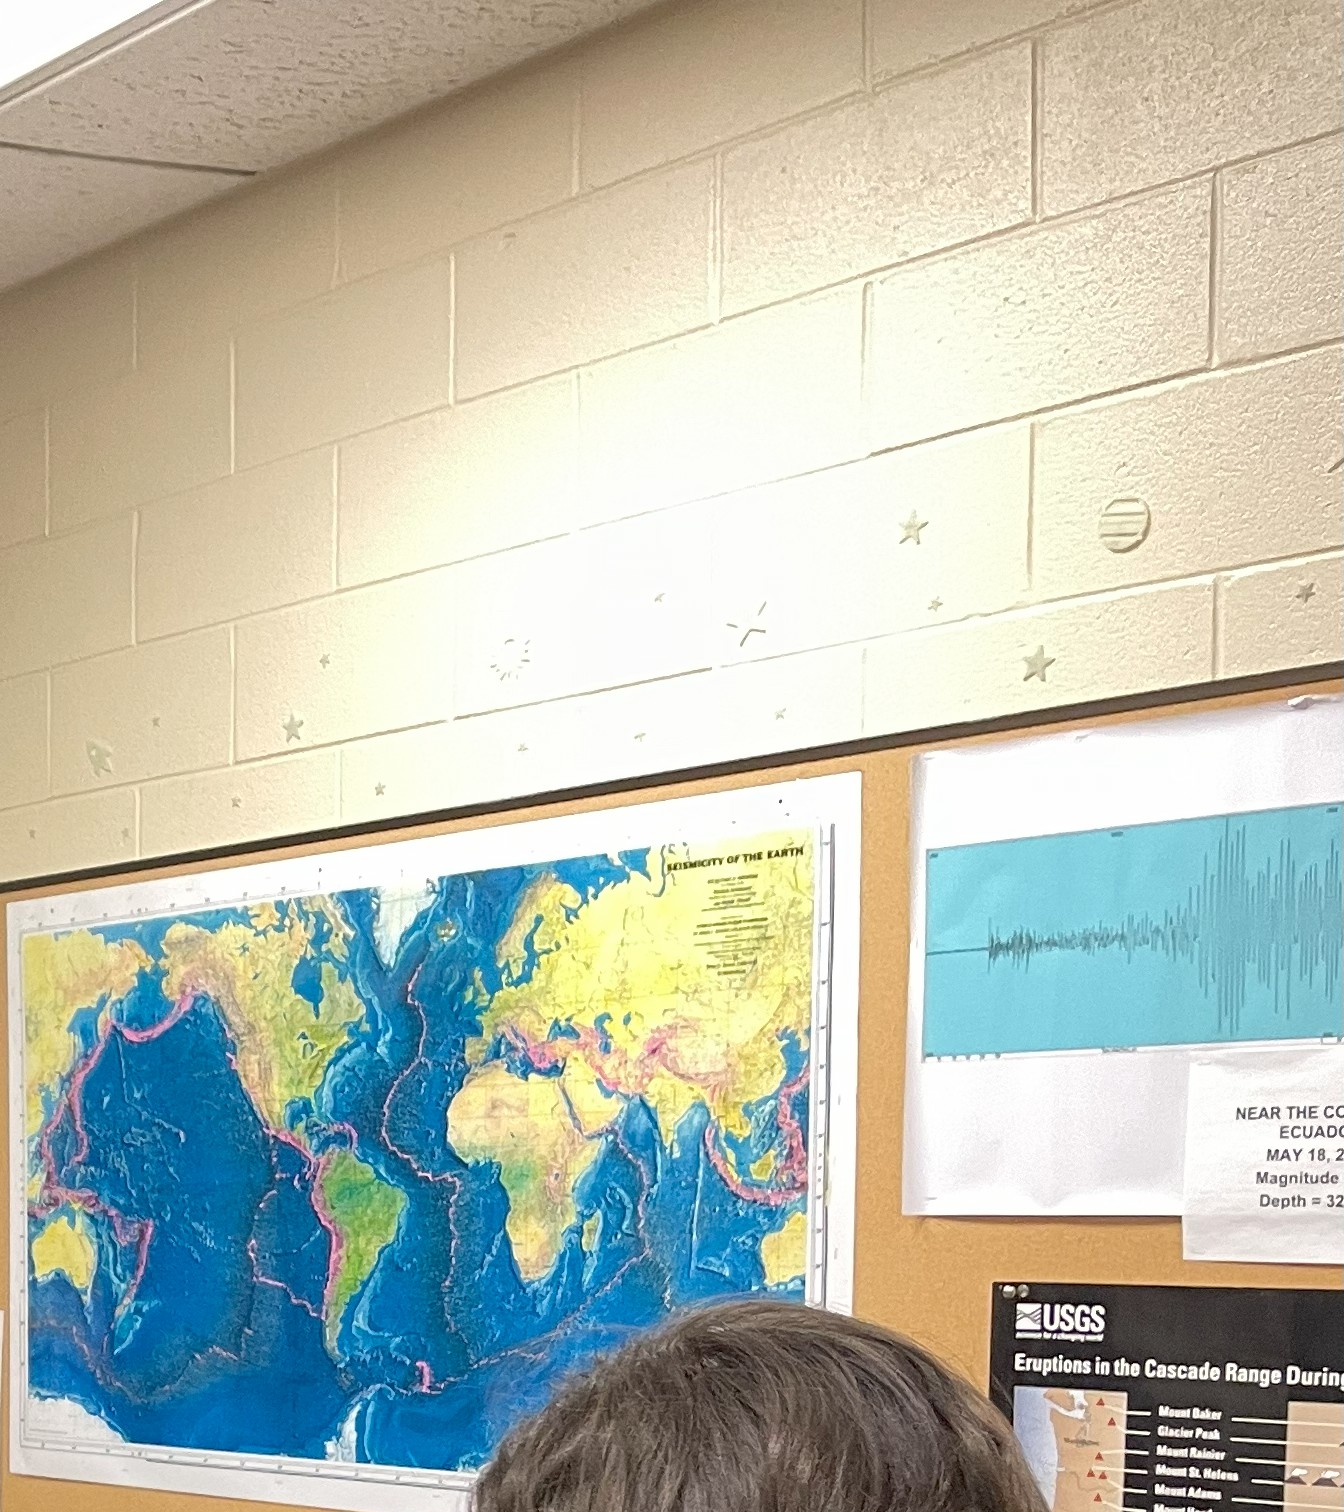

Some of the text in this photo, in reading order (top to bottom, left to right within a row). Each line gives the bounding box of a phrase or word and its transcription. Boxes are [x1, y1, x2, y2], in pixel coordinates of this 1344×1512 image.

[667, 847, 804, 872] SEISMICITY OF THE EARTH
[1236, 1106, 1281, 1120] NEAR
[1287, 1105, 1320, 1120] THE
[1266, 1148, 1303, 1161] MAY
[1308, 1148, 1331, 1164] 18,
[1256, 1171, 1340, 1188] Magnitude
[1259, 1194, 1307, 1210] Depth
[1043, 1303, 1107, 1332] USGS
[1014, 1352, 1092, 1377] Eruptions
[1095, 1356, 1111, 1376] in
[1113, 1356, 1141, 1377] the
[1144, 1358, 1221, 1382] Cascade
[1225, 1362, 1282, 1388] Range
[1158, 1405, 1223, 1421] Mount Baker
[1157, 1424, 1221, 1441] Glacier Peak
[1156, 1444, 1226, 1461] Mount Rainier
[1155, 1463, 1239, 1482] Mount St. Helens
[1154, 1483, 1222, 1501] Mount Adams
